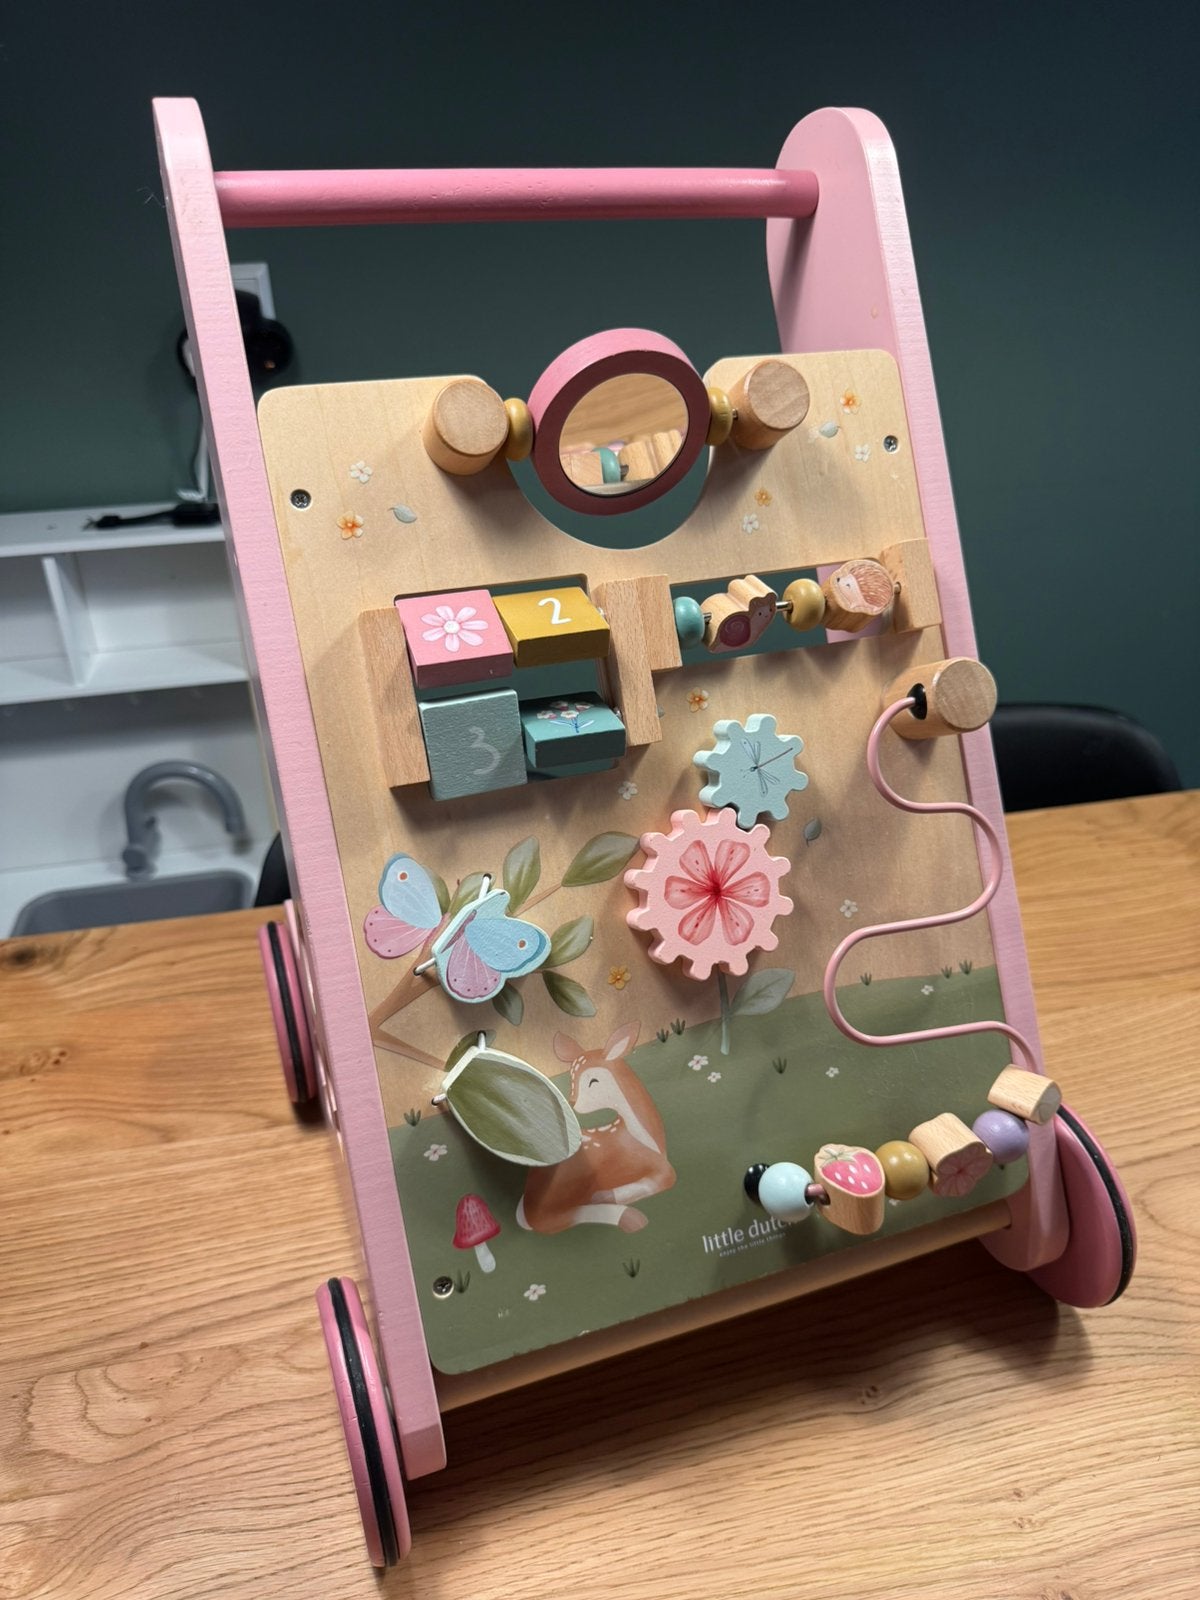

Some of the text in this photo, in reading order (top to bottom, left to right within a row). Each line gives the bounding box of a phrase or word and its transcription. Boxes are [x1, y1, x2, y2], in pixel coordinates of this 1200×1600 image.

[537, 597, 573, 625] 2
[468, 725, 501, 776] 3
[702, 1216, 797, 1253] little dutc
